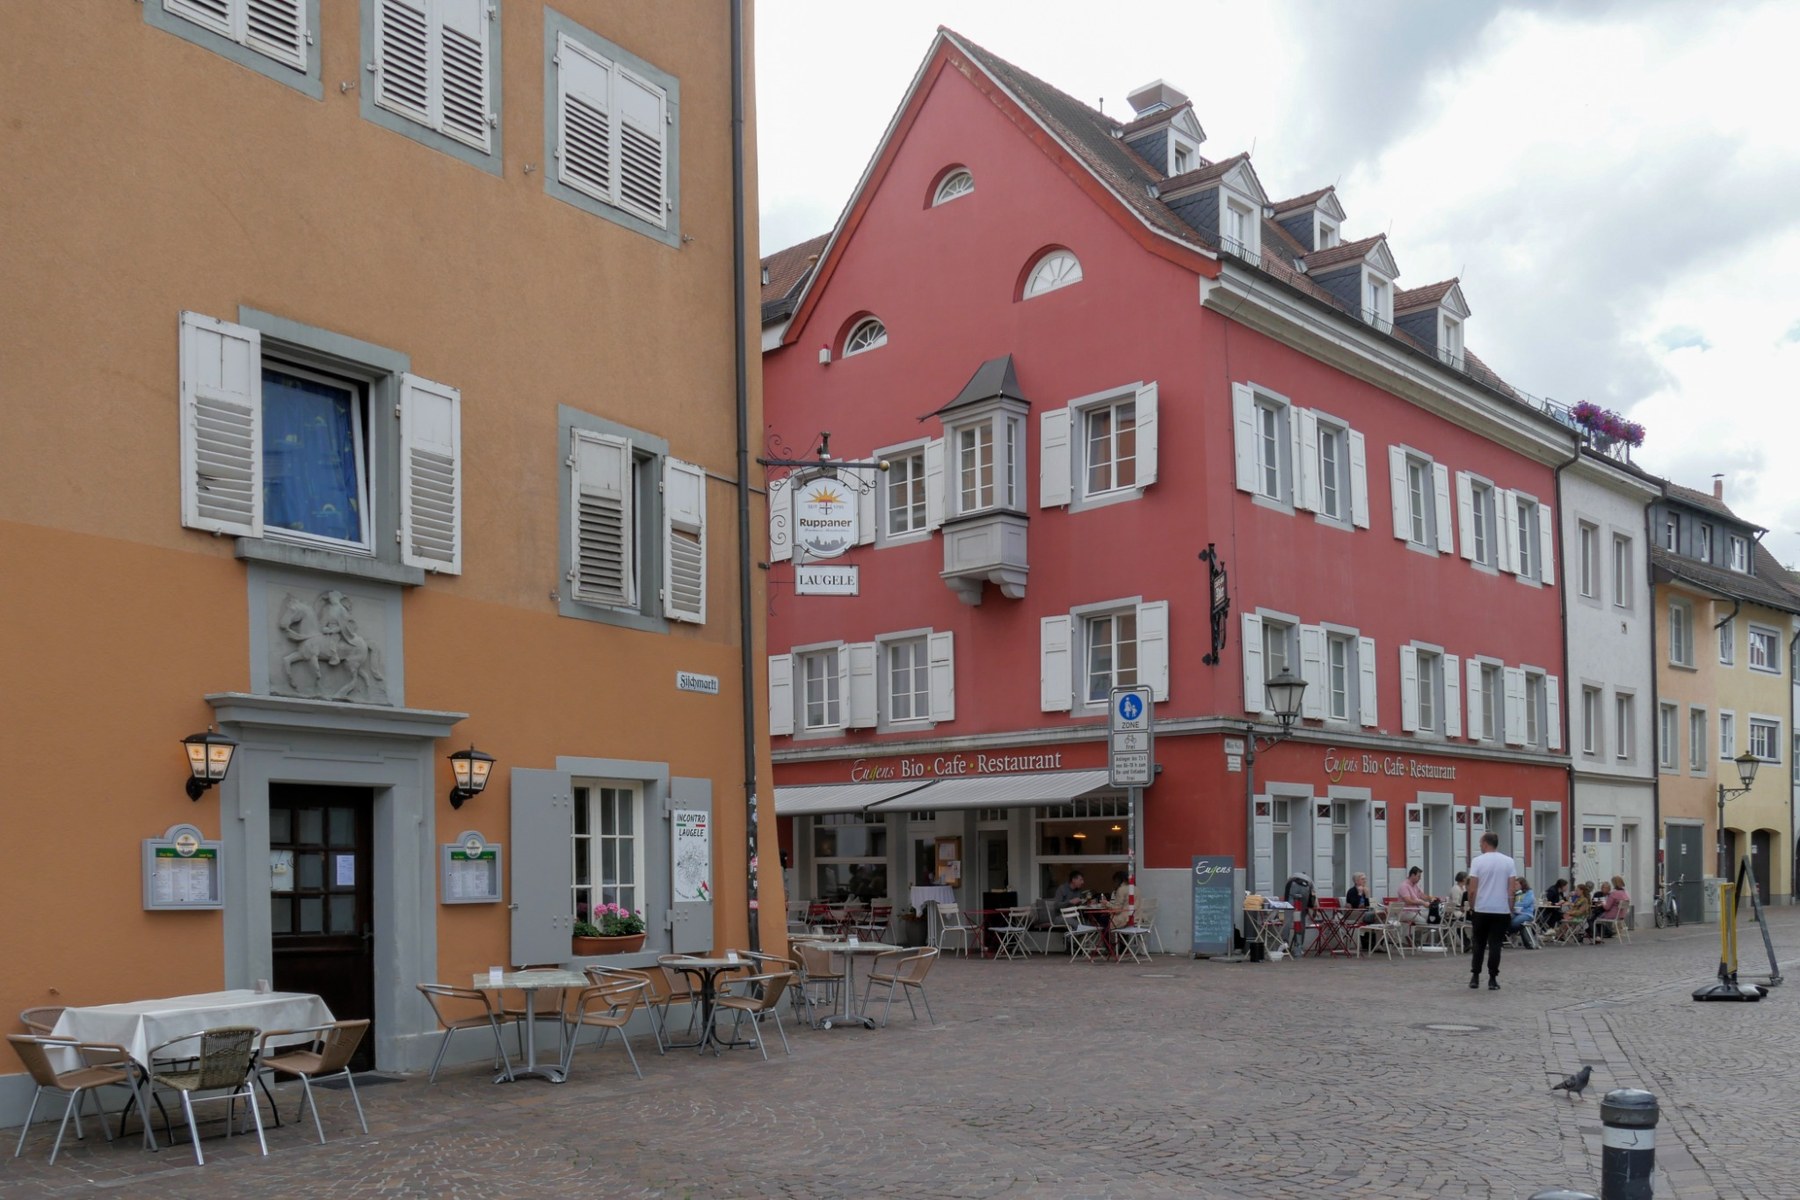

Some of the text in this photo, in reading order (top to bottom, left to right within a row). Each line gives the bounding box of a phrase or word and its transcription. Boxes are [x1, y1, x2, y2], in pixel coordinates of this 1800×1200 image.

[800, 518, 852, 528] Ruppaner
[799, 575, 855, 586] LAUGELE
[1121, 721, 1139, 729] ZONE
[851, 758, 894, 783] Eugens
[901, 758, 924, 777] Bio
[977, 752, 1061, 773] Restaurant
[1325, 747, 1358, 782] Eugens
[1362, 755, 1378, 774] Bio
[1410, 759, 1456, 780] Restaurant
[677, 814, 706, 822] INCONTRO
[679, 829, 704, 837] LAUGELE
[1196, 861, 1232, 884] Eugens
